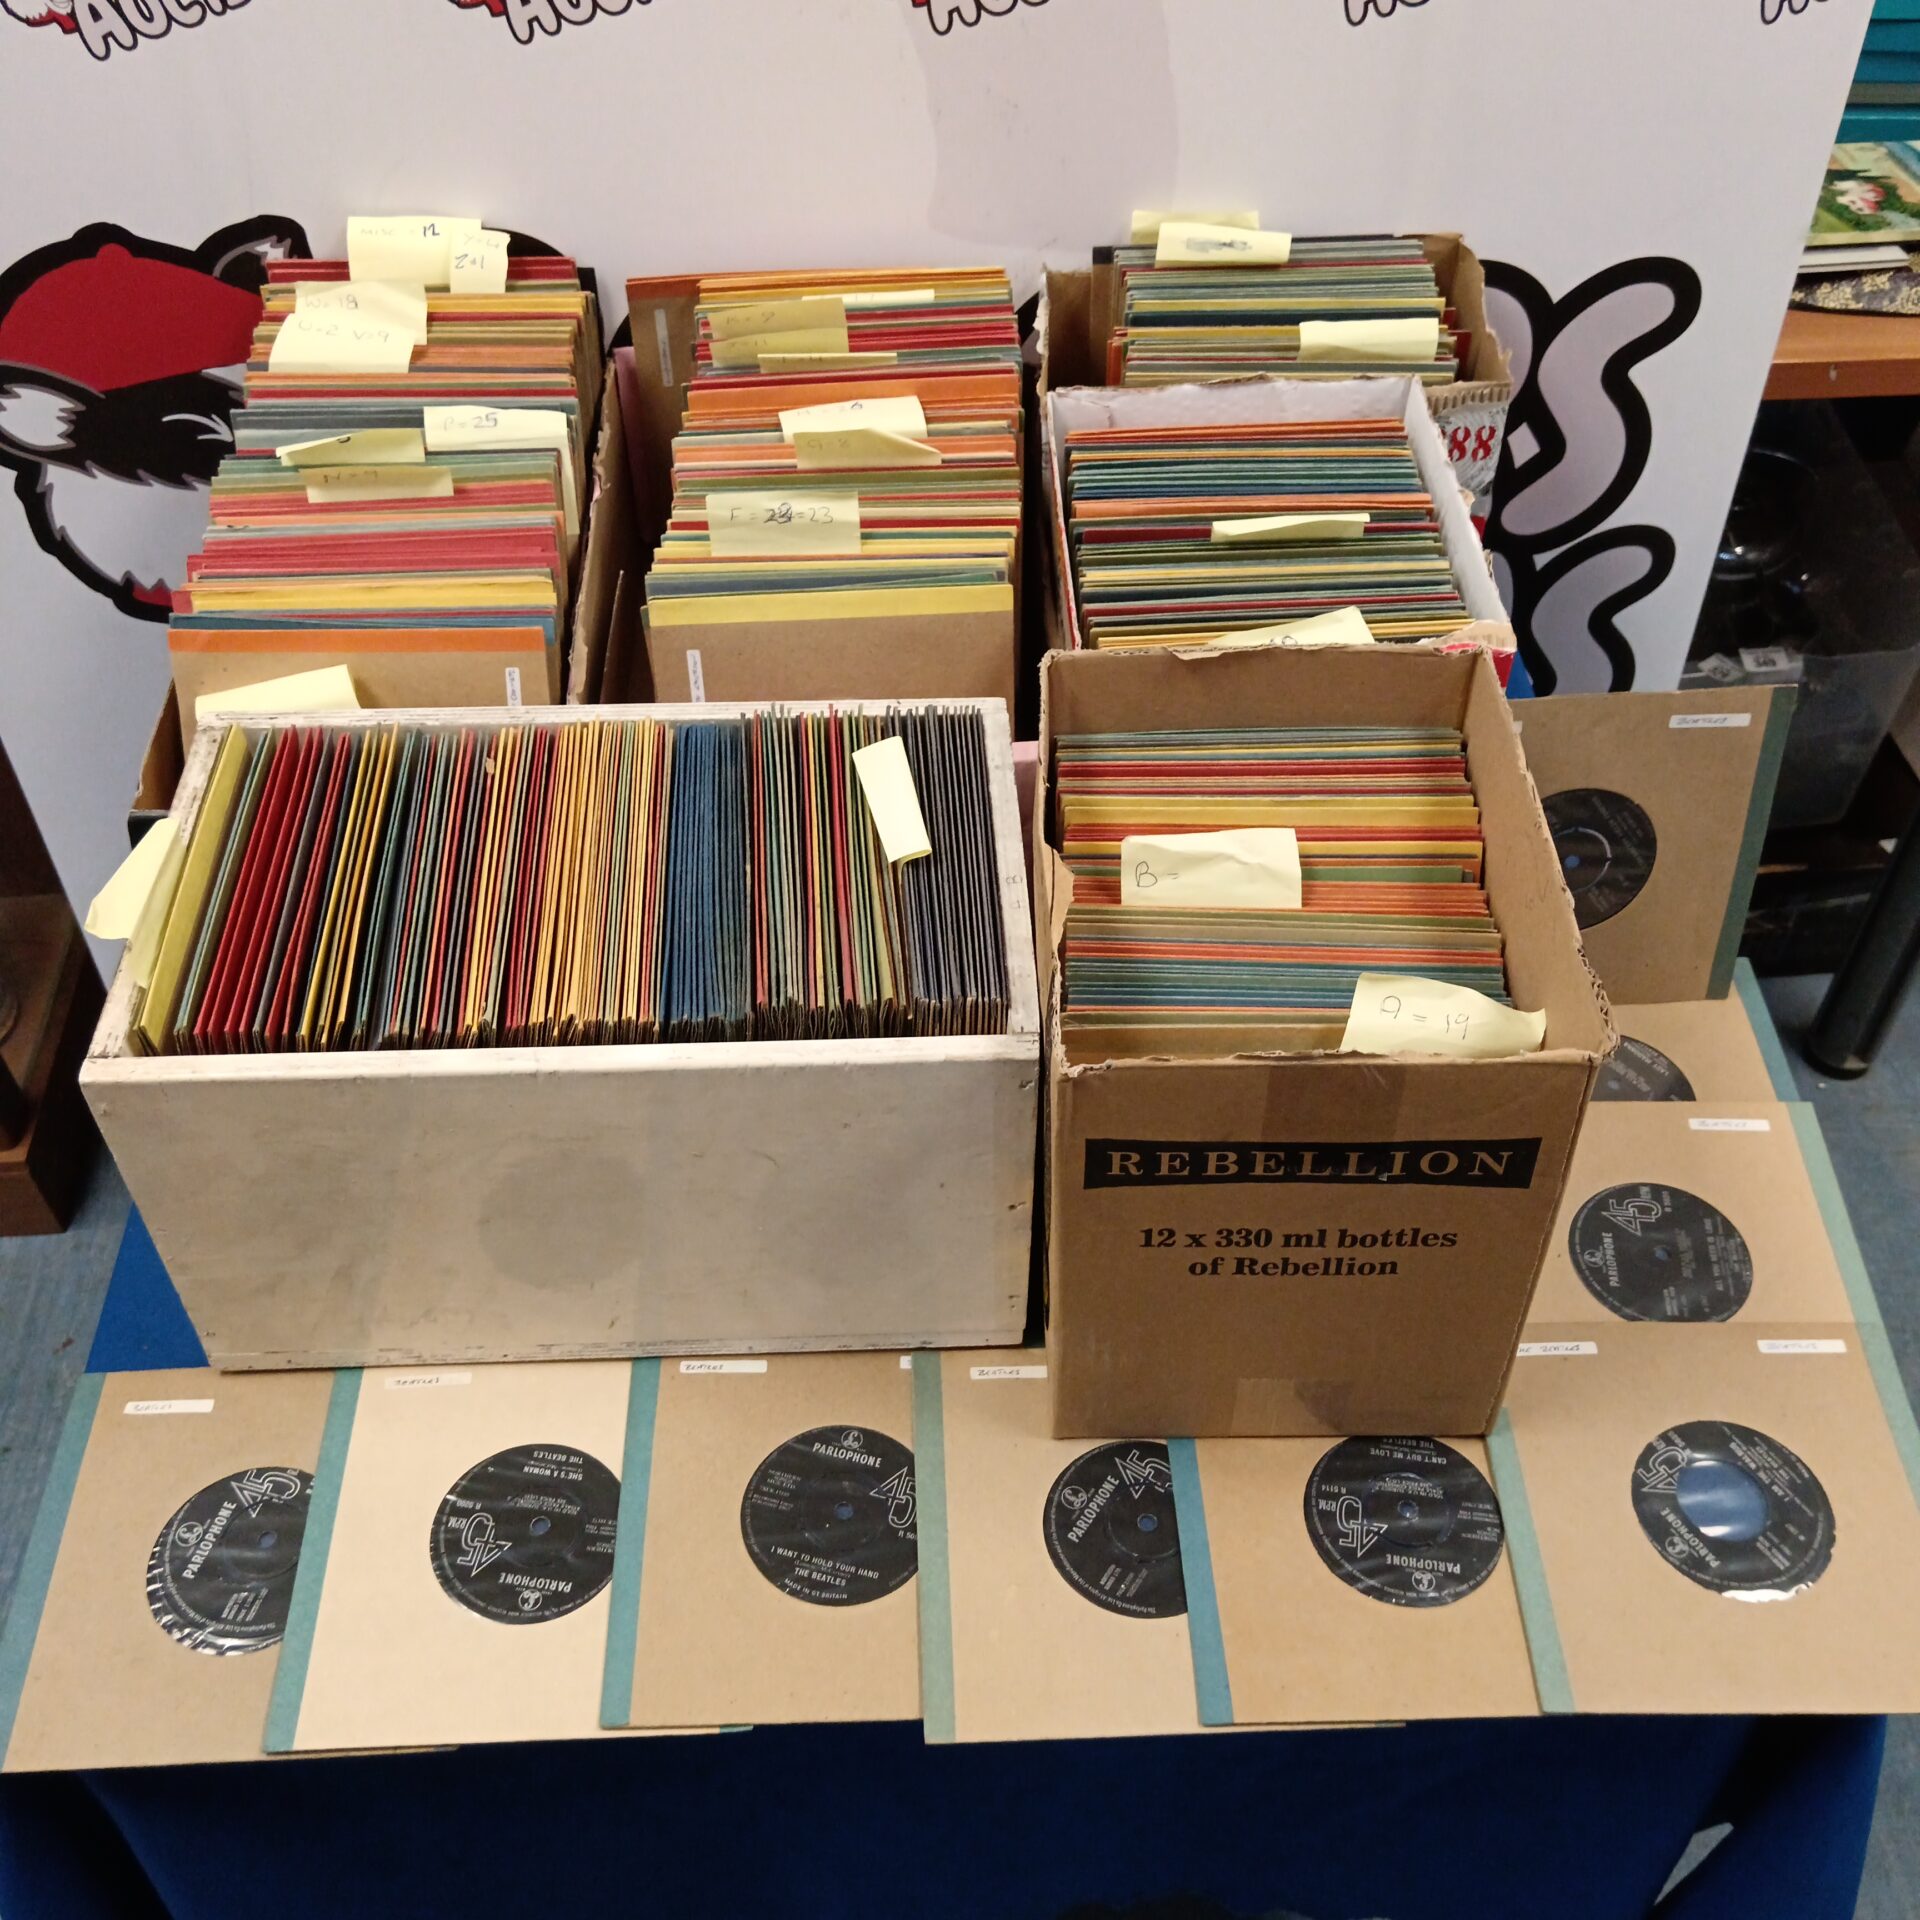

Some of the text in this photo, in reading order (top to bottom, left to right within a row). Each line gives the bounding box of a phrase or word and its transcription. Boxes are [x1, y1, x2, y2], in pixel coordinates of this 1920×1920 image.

[1440, 425, 1497, 462] 88
[1135, 861, 1158, 888] B
[1105, 1150, 1515, 1177] REBELLION
[1601, 1198, 1662, 1237] 45
[1139, 1226, 1458, 1249] 12 x 330 ml bottles
[1188, 1255, 1398, 1277] of Rebellion
[1602, 1231, 1620, 1287] PARLOPHONE
[533, 1451, 583, 1464] THE BEATLES
[812, 1442, 882, 1468] PARLOPHONE
[1370, 1447, 1447, 1465] CAN'T BUY ME LOVE
[1422, 1440, 1436, 1449] THE
[523, 1465, 550, 1477] WOMAN
[553, 1468, 559, 1478] A
[563, 1468, 583, 1481] SHE'S
[230, 1469, 301, 1518] 45
[869, 1466, 917, 1528] 45
[1318, 1499, 1336, 1512] RPM
[448, 1516, 467, 1529] RPM
[1067, 1475, 1120, 1544] PARLOPHONE
[1336, 1495, 1388, 1558] 45
[1659, 1506, 1721, 1569] PARLOPHONE
[182, 1501, 237, 1579] PARLOPHONE
[457, 1512, 512, 1577] 45
[770, 1545, 775, 1553] I
[776, 1546, 799, 1560] WANT
[801, 1552, 810, 1562] TO
[811, 1555, 833, 1568] HOLD
[835, 1560, 857, 1573] YOUR
[858, 1565, 879, 1579] HAND
[1386, 1553, 1461, 1574] PARLOPHONE
[498, 1572, 573, 1593] PARLOPHONE
[794, 1567, 810, 1578] THE
[811, 1571, 846, 1586] BEATLES
